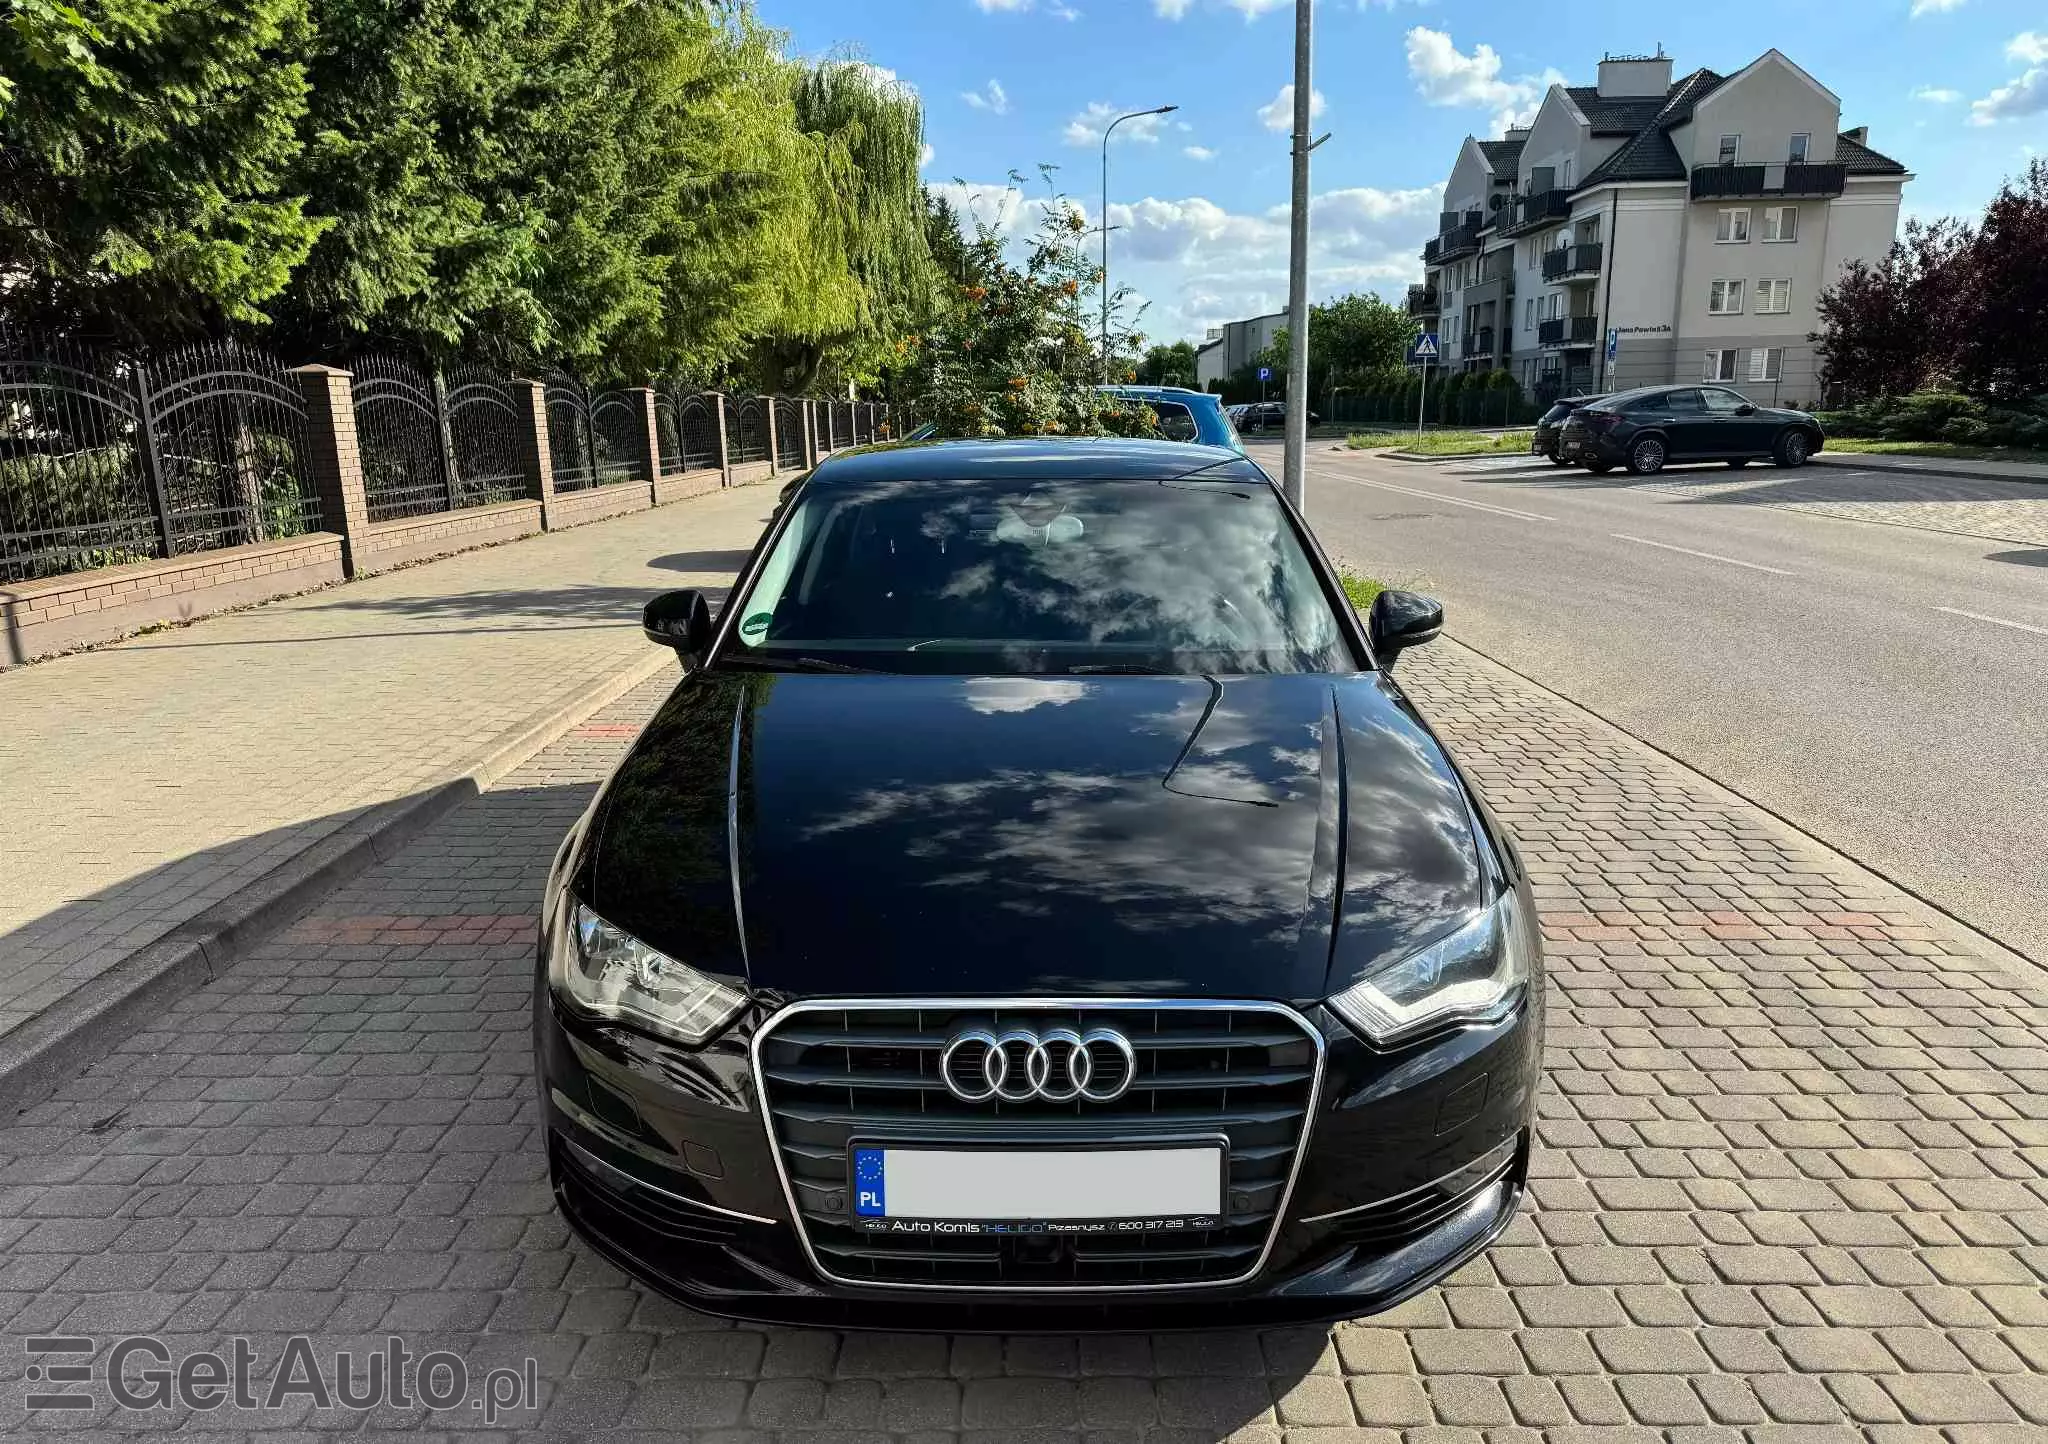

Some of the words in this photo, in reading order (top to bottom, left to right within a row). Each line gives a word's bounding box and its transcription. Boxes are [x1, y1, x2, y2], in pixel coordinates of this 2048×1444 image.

[1610, 330, 1616, 350] P
[1260, 368, 1269, 380] P
[860, 1191, 881, 1207] PL
[891, 1220, 931, 1232] Auto
[934, 1221, 980, 1233] Komis
[1118, 1221, 1143, 1230] 600
[1144, 1220, 1163, 1229] 317
[1165, 1219, 1184, 1228] 213
